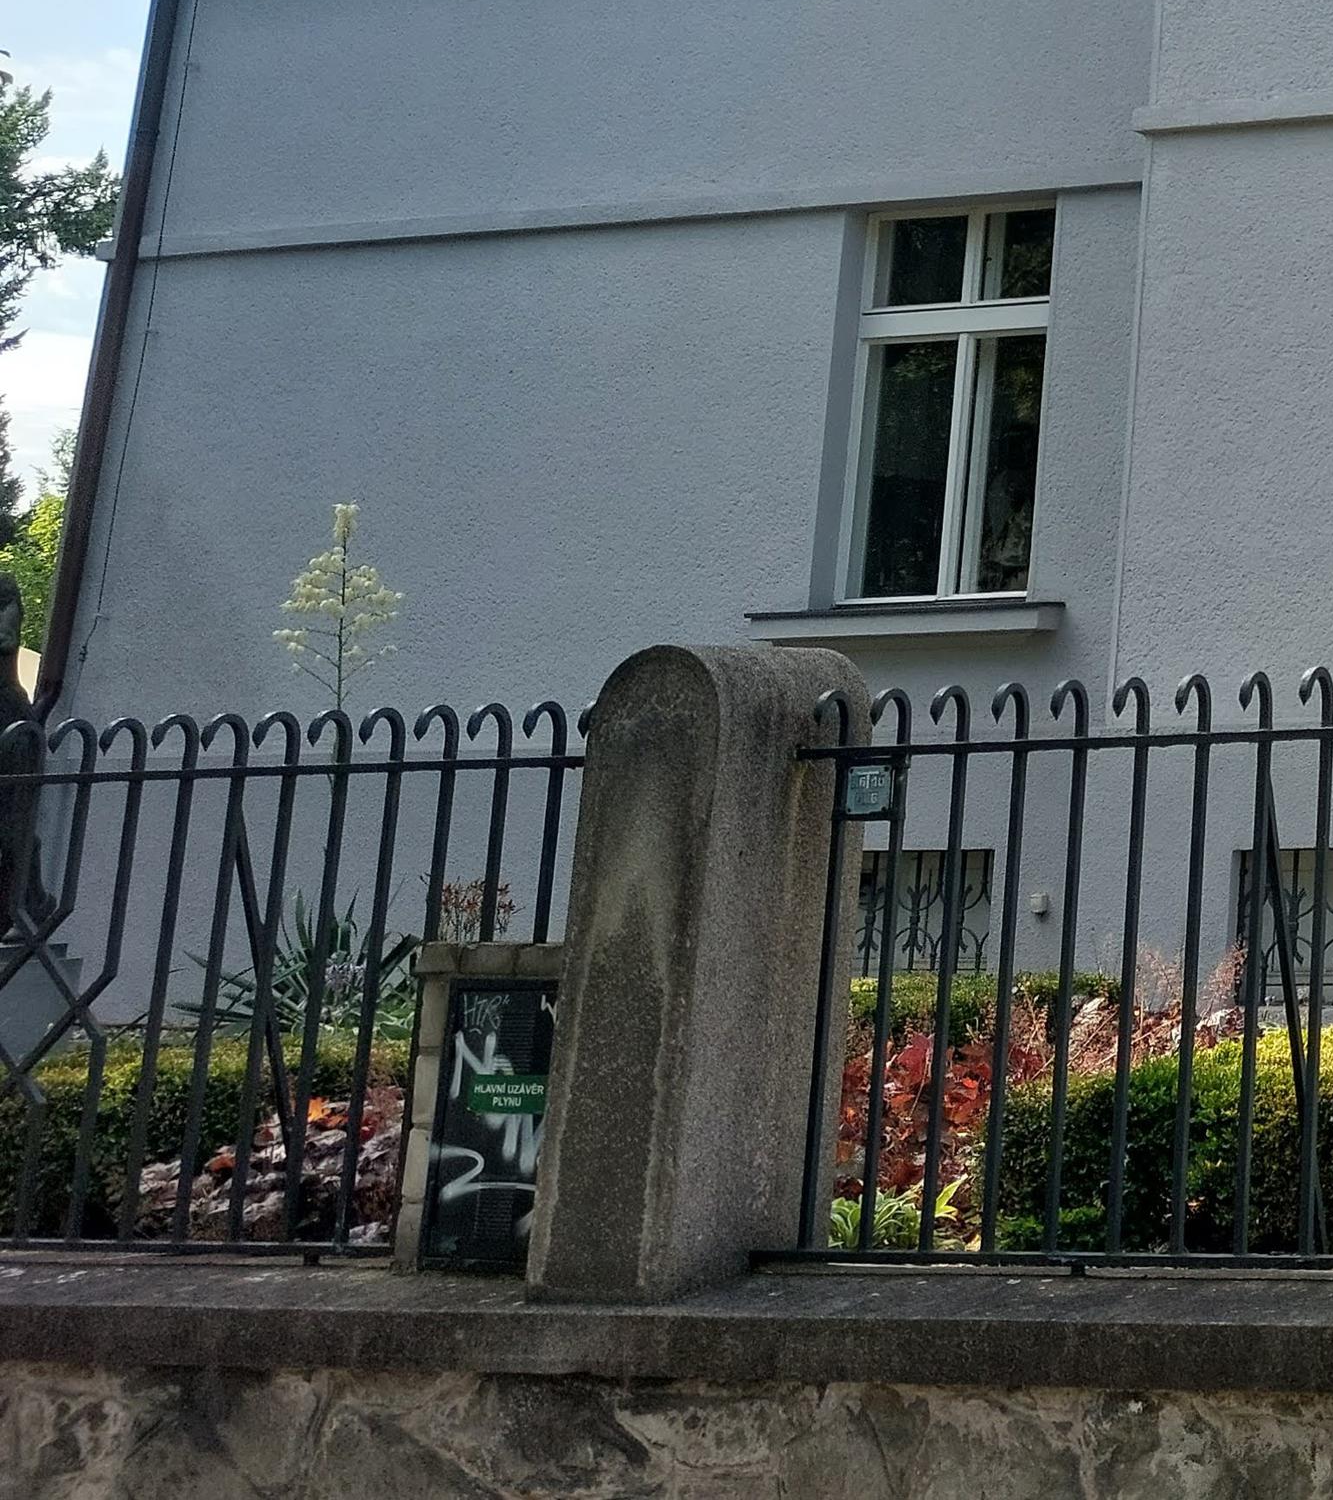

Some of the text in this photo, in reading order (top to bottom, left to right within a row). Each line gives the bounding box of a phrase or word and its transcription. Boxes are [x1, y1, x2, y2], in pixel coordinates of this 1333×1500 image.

[474, 1082, 545, 1095] HLAVNÍ UZÁVĚR
[492, 1096, 522, 1107] PLYNU
